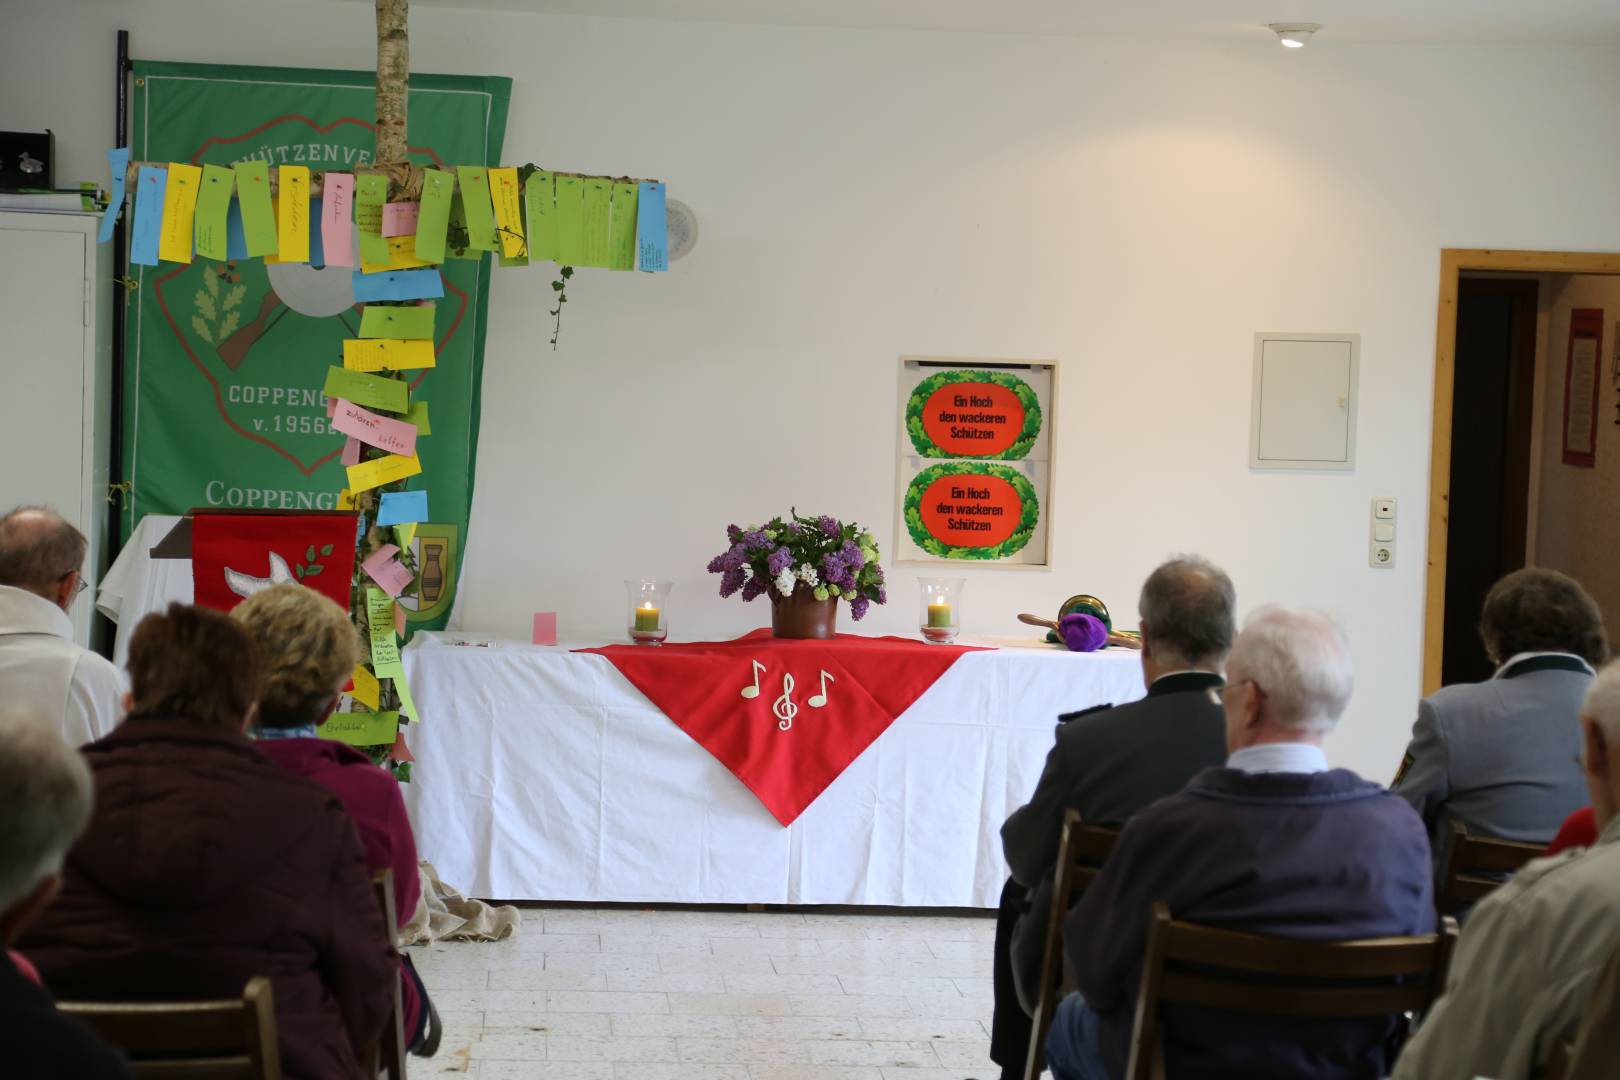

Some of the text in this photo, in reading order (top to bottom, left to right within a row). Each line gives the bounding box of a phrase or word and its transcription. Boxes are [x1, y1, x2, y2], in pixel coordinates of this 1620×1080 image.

[954, 395, 993, 408] Ein Hoch
[939, 411, 1006, 424] den wackeren
[950, 427, 995, 440] Schützen
[951, 487, 990, 499] Ein Hoch
[936, 503, 1003, 515] den wackeren
[947, 518, 992, 531] Schützen
